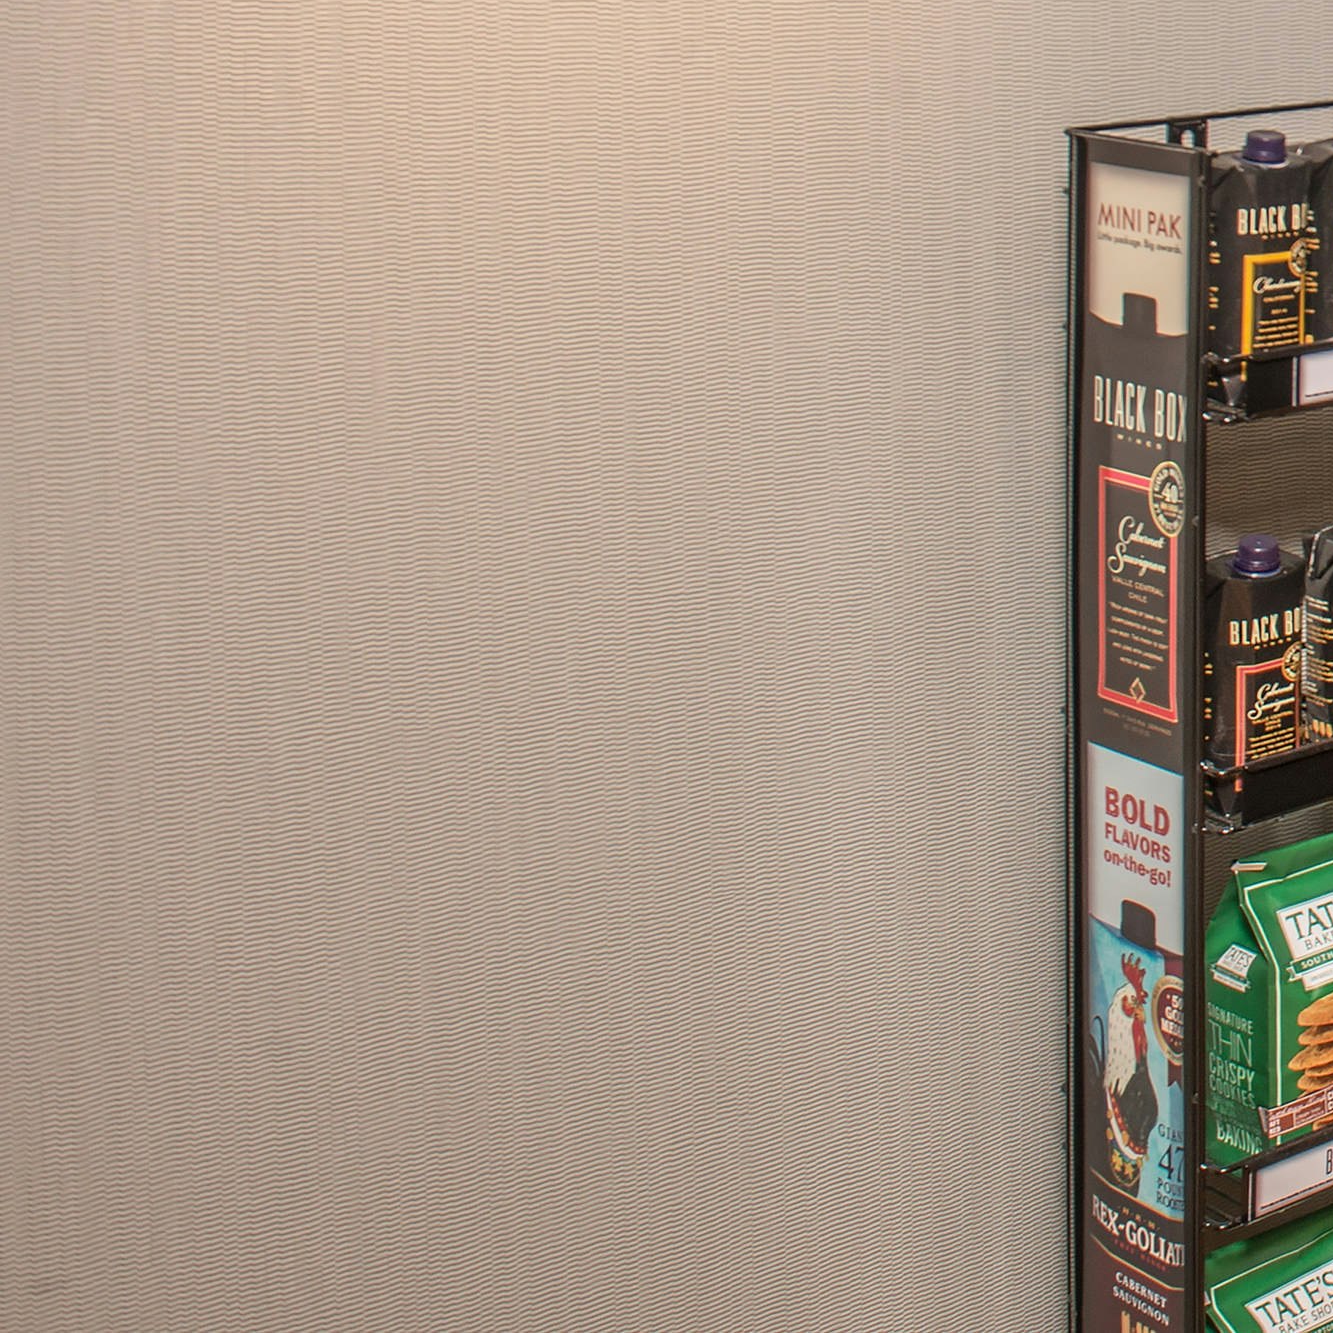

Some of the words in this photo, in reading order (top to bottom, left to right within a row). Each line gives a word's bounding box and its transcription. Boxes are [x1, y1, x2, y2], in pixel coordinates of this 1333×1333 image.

[1097, 202, 1142, 233] MINI
[1147, 210, 1182, 239] PAK
[1236, 205, 1287, 236] BLACK
[1093, 374, 1147, 434] BLACK
[1154, 388, 1187, 443] BOX
[1118, 515, 1167, 550] Cabernet
[1107, 542, 1167, 577] Sauvignon
[1229, 610, 1279, 646] BLACK
[1104, 785, 1171, 837] BOLD
[1104, 821, 1172, 864] FLAVORS
[1103, 847, 1172, 888] on-the-go!
[1208, 1019, 1252, 1067] THIN
[1208, 1052, 1255, 1092] CRISPY
[1112, 1285, 1170, 1326] SAUVIGNON
[1115, 1270, 1168, 1307] CABERNET
